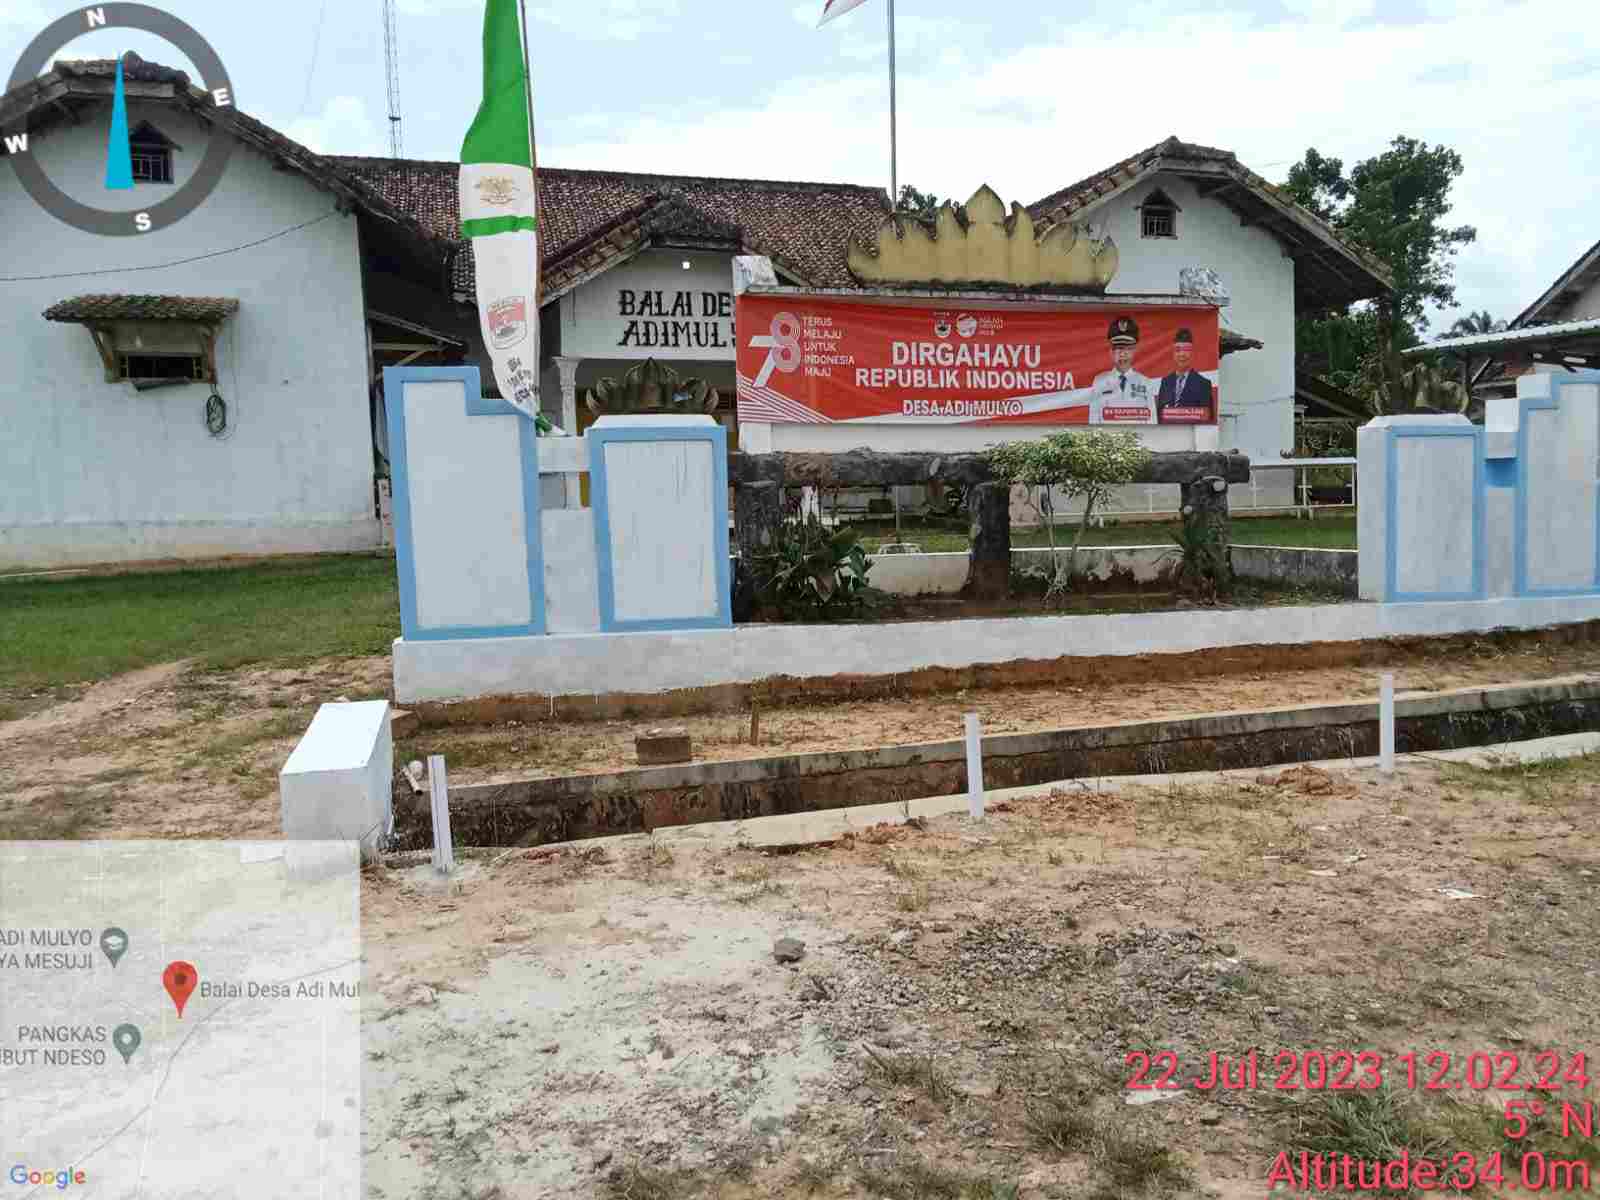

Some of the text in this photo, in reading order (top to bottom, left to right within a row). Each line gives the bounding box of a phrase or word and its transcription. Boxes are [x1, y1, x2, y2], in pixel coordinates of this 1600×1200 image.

[618, 289, 736, 317] BALAI DE
[803, 316, 832, 327] TERUS
[892, 341, 1041, 369] DIRGAHAYU
[855, 367, 1075, 390] REPUBLIK INDONESIA
[903, 399, 939, 416] DESA
